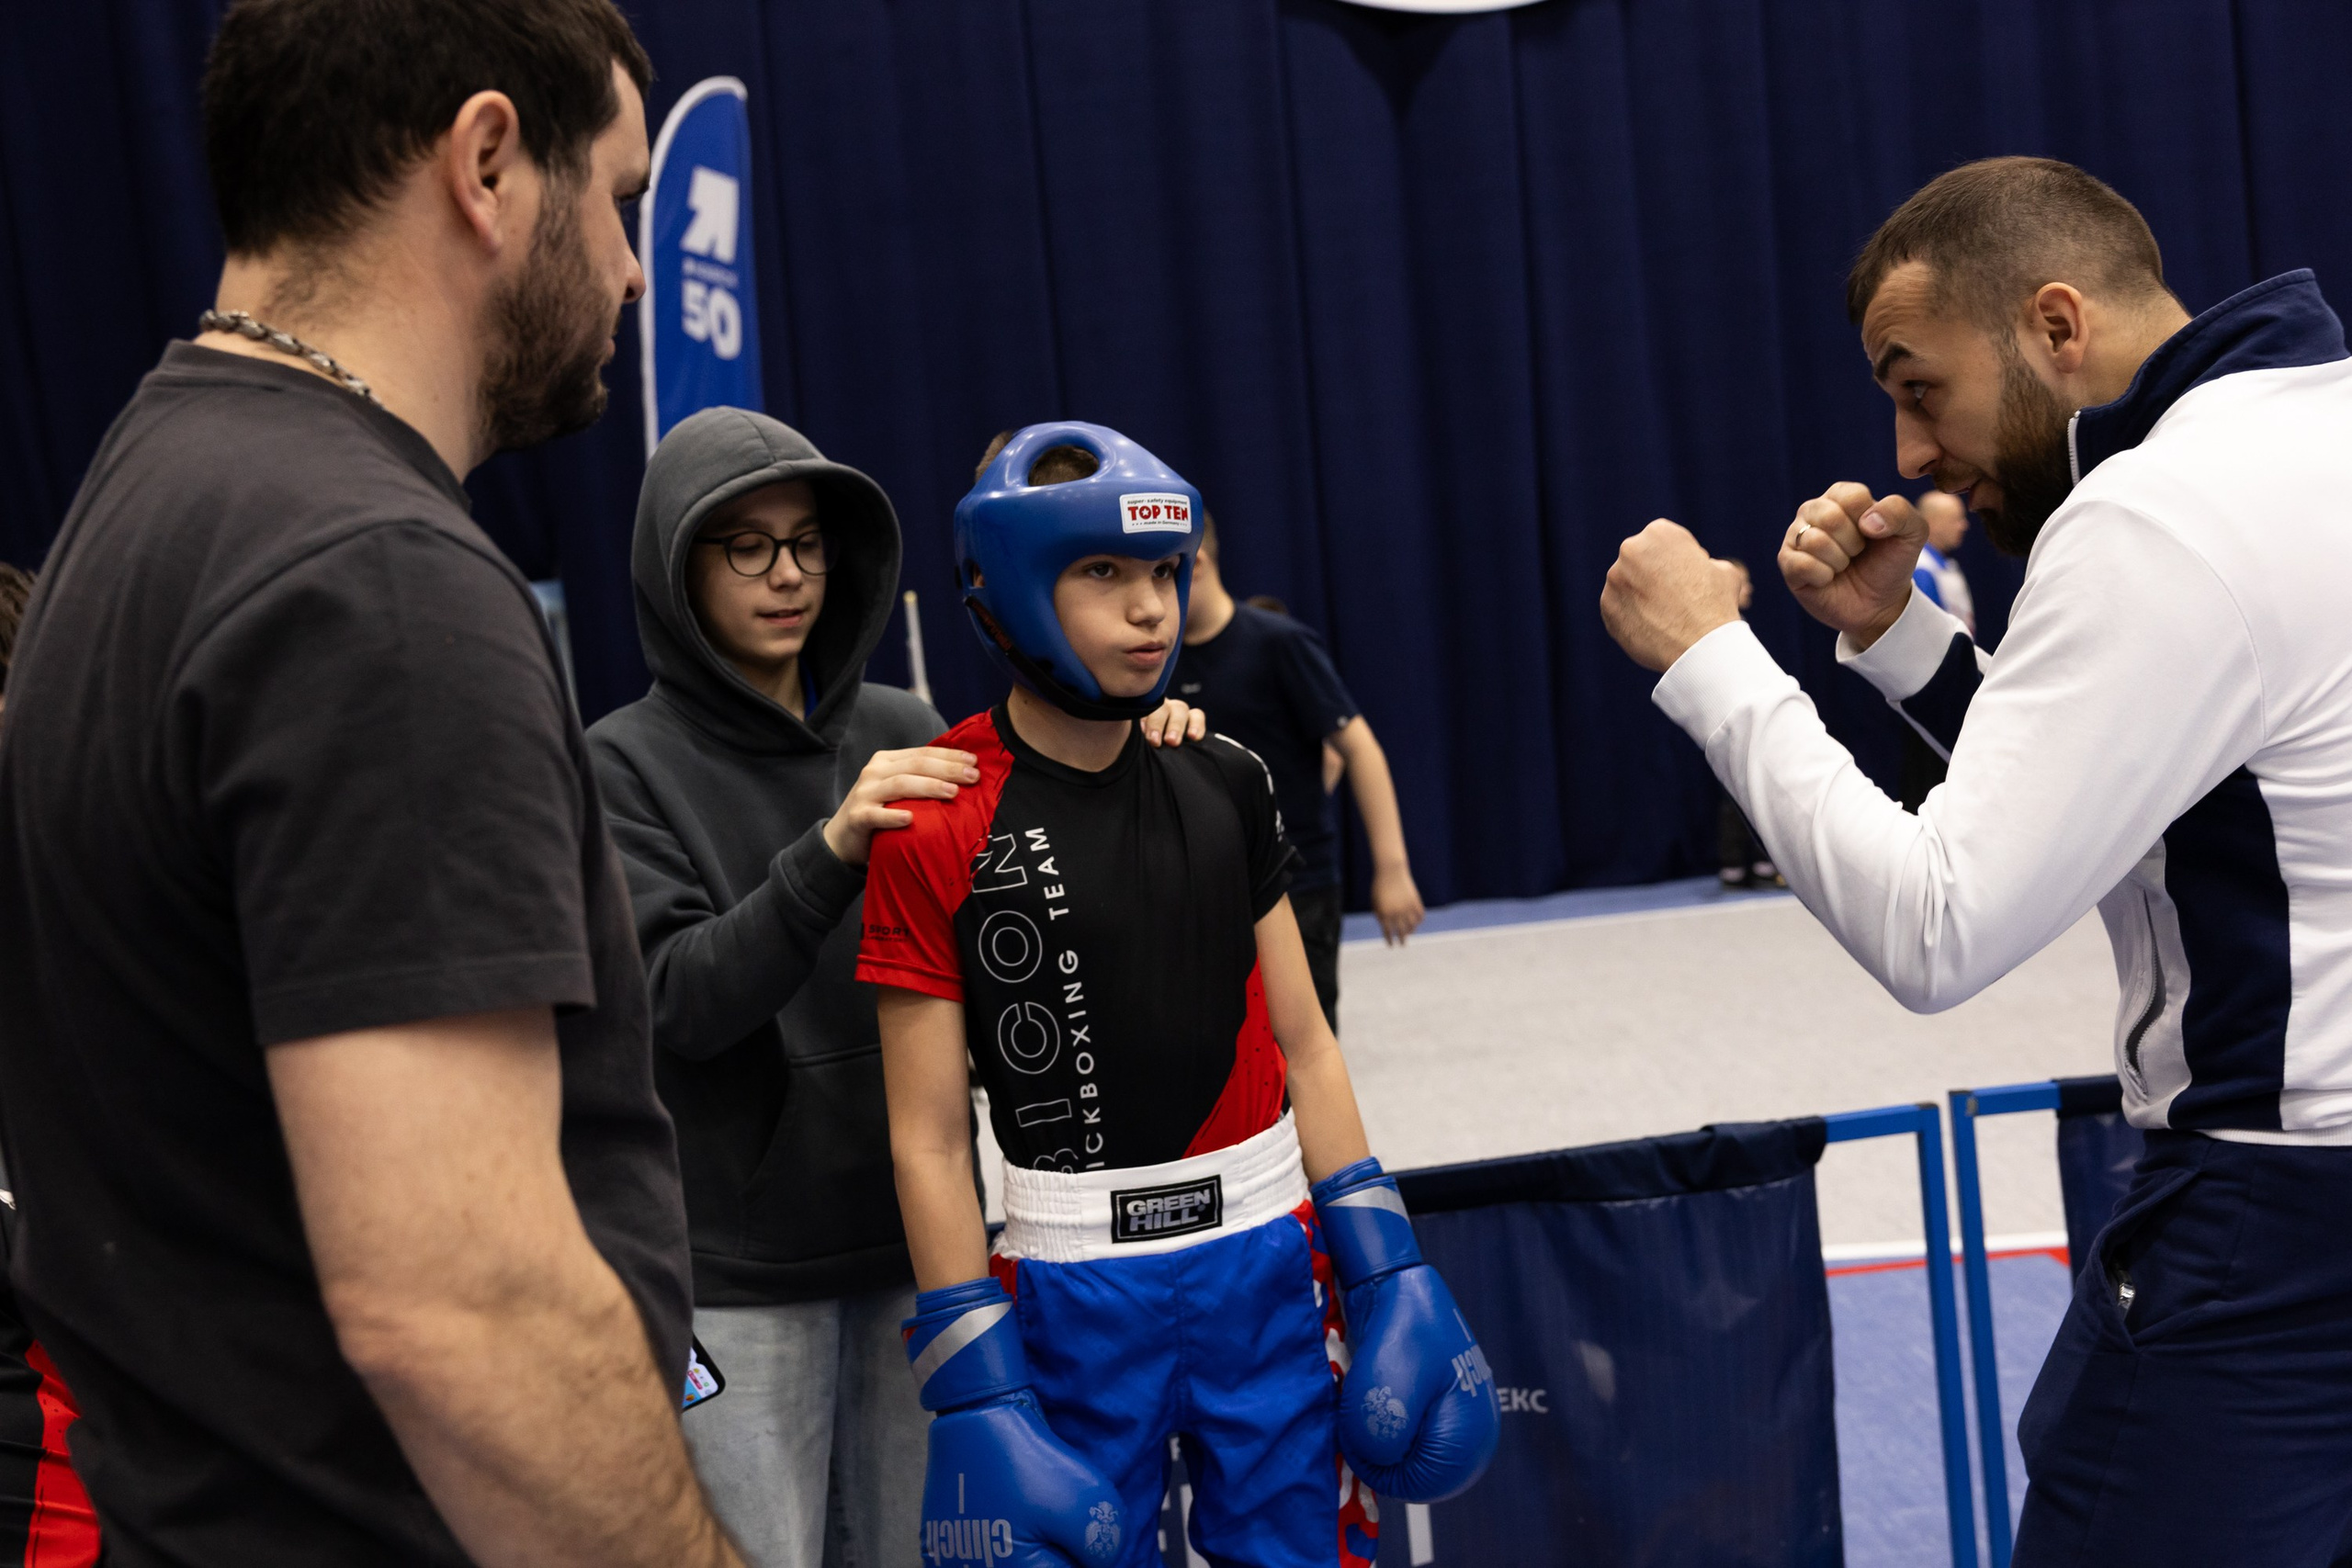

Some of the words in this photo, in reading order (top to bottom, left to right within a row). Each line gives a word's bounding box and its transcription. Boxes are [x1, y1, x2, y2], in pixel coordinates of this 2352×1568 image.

[681, 279, 742, 359] 50
[1127, 505, 1160, 521] TOP
[1164, 505, 1188, 521] TEN
[1024, 827, 1070, 921] TEAM
[1058, 949, 1105, 1170] ICKBOXING
[1126, 1188, 1211, 1216] GREEN
[1129, 1207, 1200, 1233] HILL
[926, 1518, 1013, 1568] clinch
